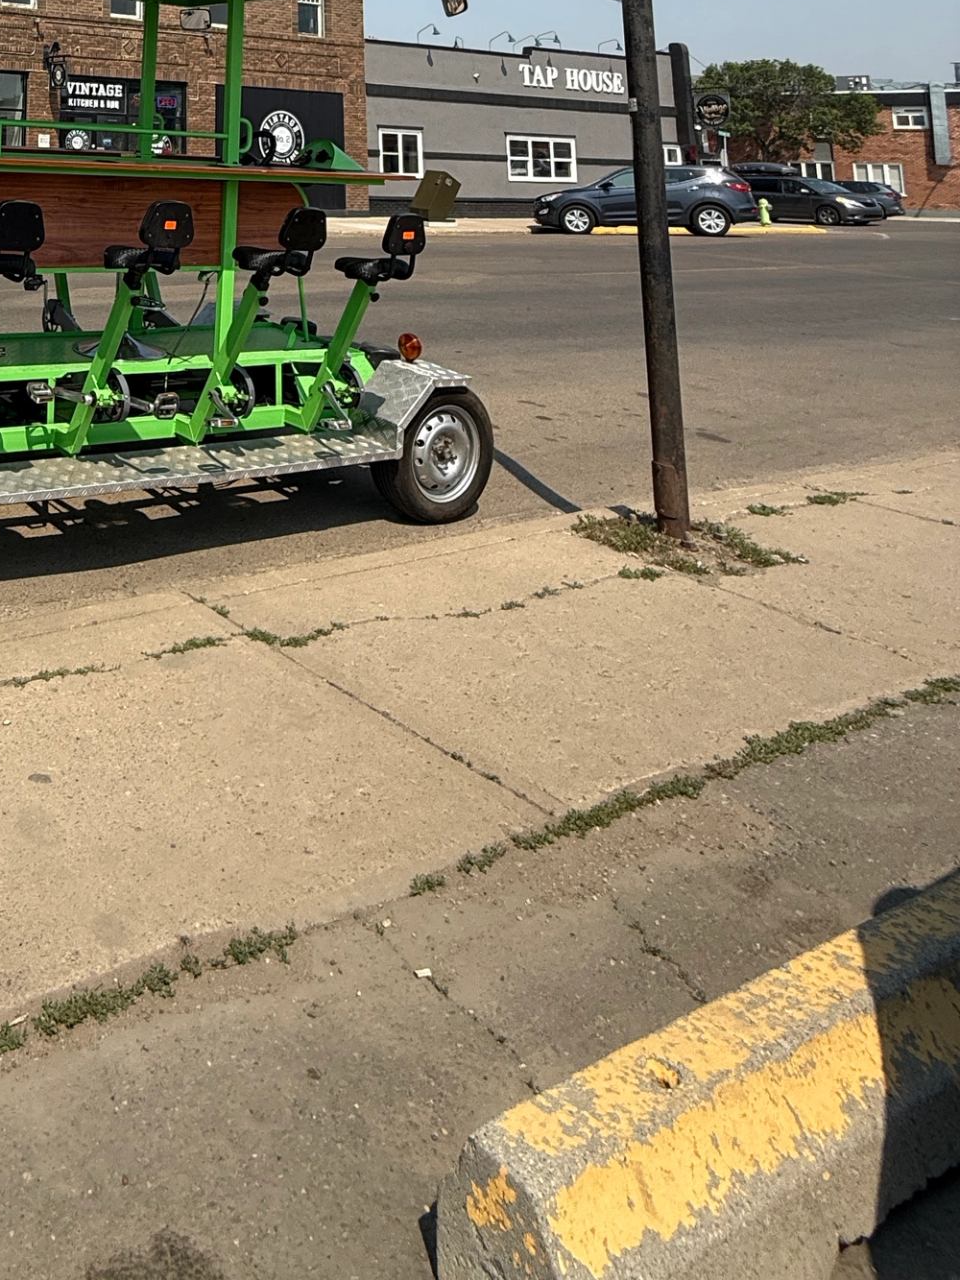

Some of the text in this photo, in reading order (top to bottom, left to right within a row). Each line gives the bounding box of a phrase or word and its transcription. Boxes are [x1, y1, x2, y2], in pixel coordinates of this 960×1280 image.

[66, 81, 123, 97] VINTAGE
[518, 63, 625, 95] TAP HOUSE
[262, 113, 301, 133] VINTAGE
